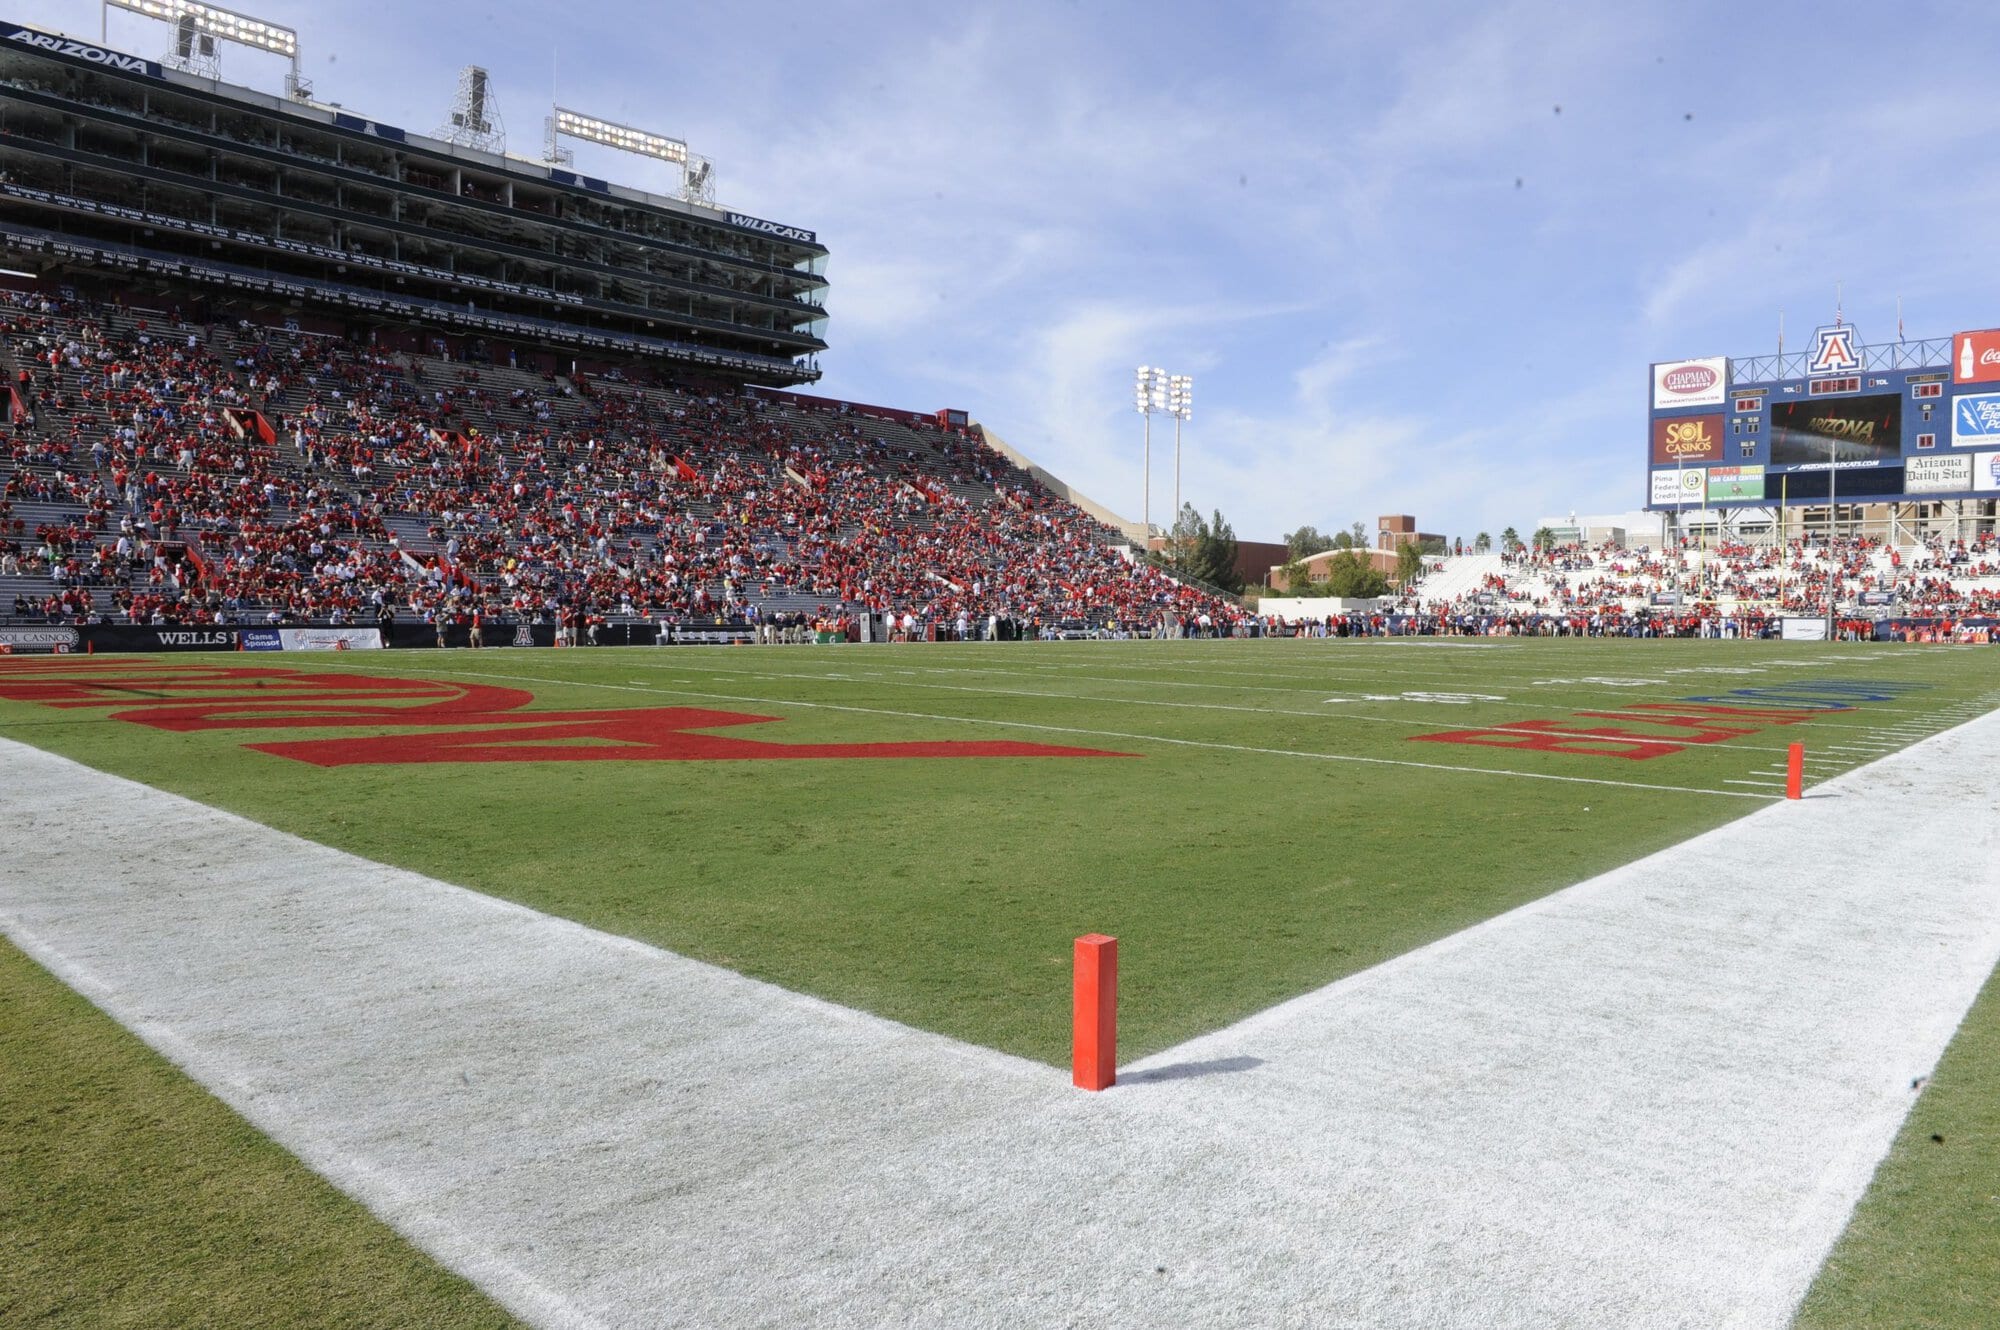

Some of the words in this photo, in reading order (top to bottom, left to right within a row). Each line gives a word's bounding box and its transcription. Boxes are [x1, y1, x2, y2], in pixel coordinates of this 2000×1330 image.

[7, 29, 149, 75] ARIZONA
[730, 214, 812, 241] WILDCATS
[69, 246, 94, 255] STANTON
[1667, 370, 1711, 385] CHAPMAN
[1666, 421, 1712, 444] SOL
[1808, 417, 1875, 437] ARIZONA
[1665, 441, 1712, 453] CASINOS
[1914, 457, 1962, 469] Arizona
[1906, 469, 1939, 482] Daily
[1942, 468, 1969, 480] Star
[0, 633, 20, 642] SOL
[24, 633, 70, 642] CASINOS
[157, 631, 228, 645] WELLS
[244, 639, 280, 648] Sponsor
[1407, 703, 1859, 760] BEAR
[1677, 678, 1938, 709] DOWN
